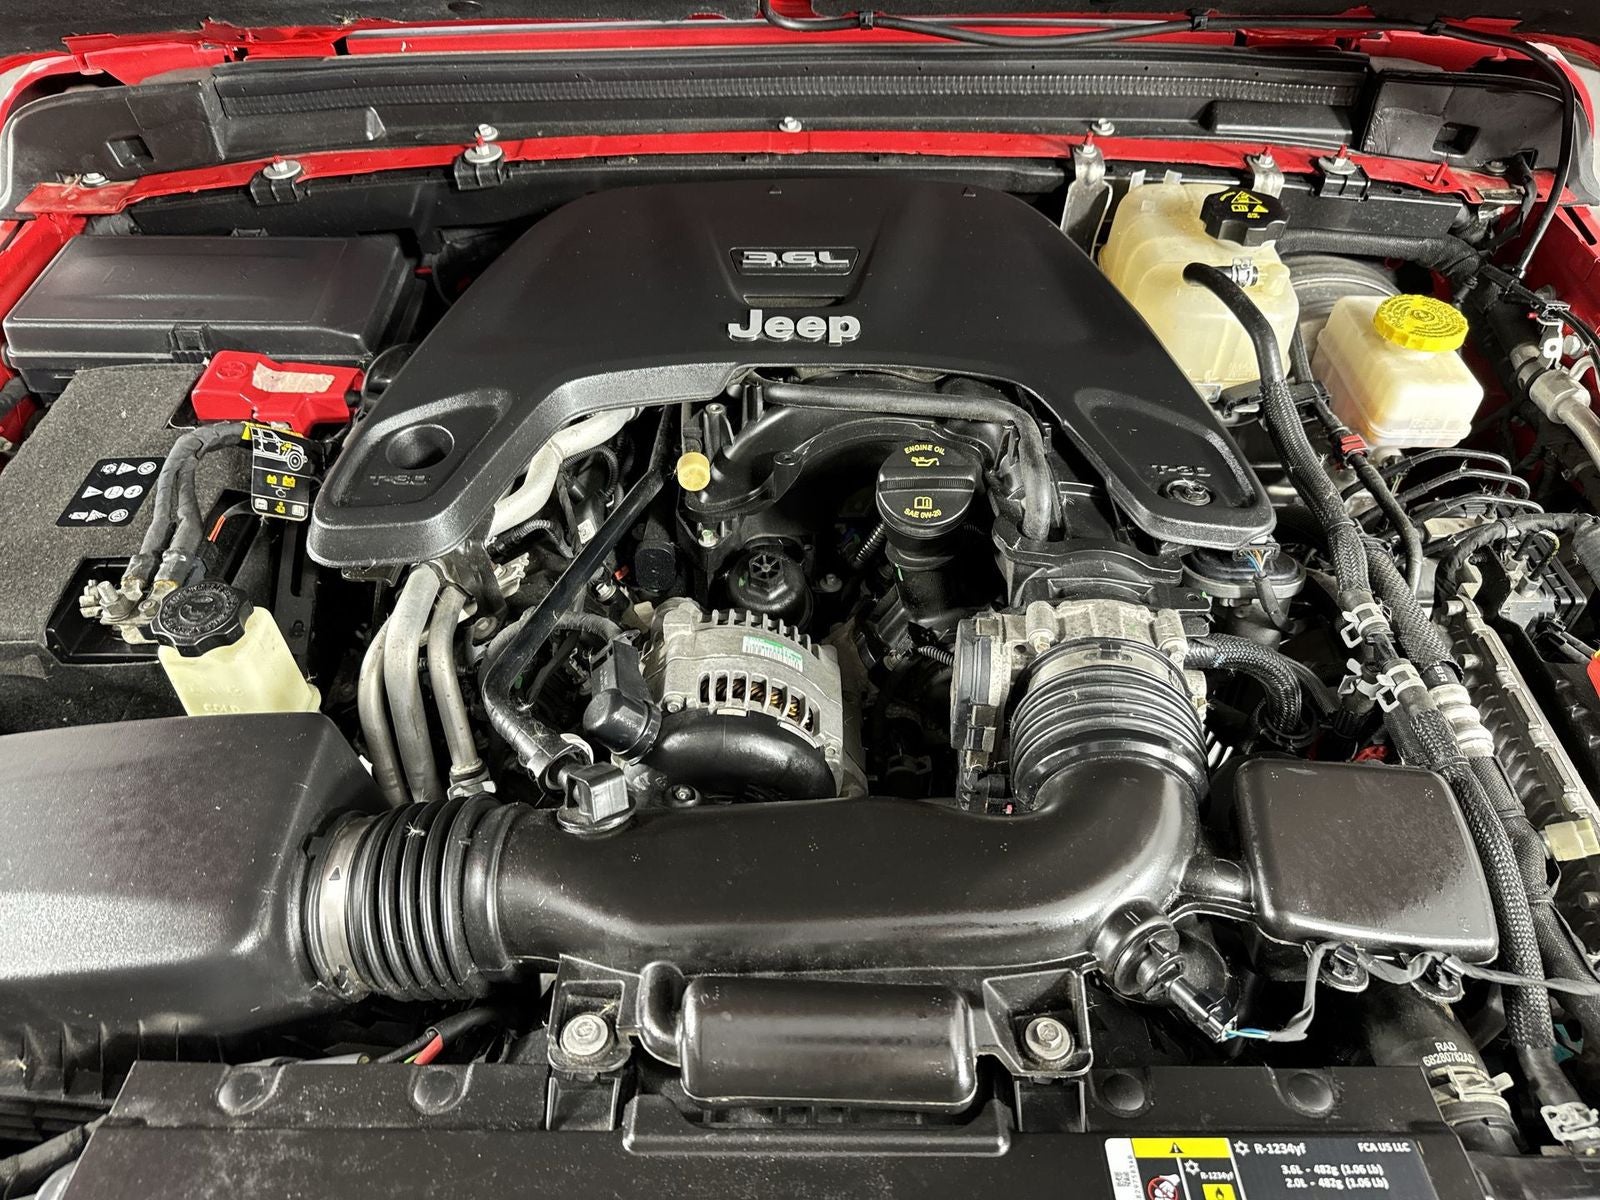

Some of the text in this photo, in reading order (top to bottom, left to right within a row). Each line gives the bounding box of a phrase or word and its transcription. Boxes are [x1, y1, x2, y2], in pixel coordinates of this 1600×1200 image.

[742, 251, 850, 268] 3.6L
[728, 309, 861, 347] Jeep
[904, 444, 945, 456] ENGINE OIL
[904, 508, 920, 519] SAE
[1434, 1041, 1458, 1052] RAD
[1253, 1142, 1411, 1157] R-1234yf FCA US LLC
[1280, 1164, 1304, 1175] 3.6L
[1285, 1177, 1309, 1188] 2.0L
